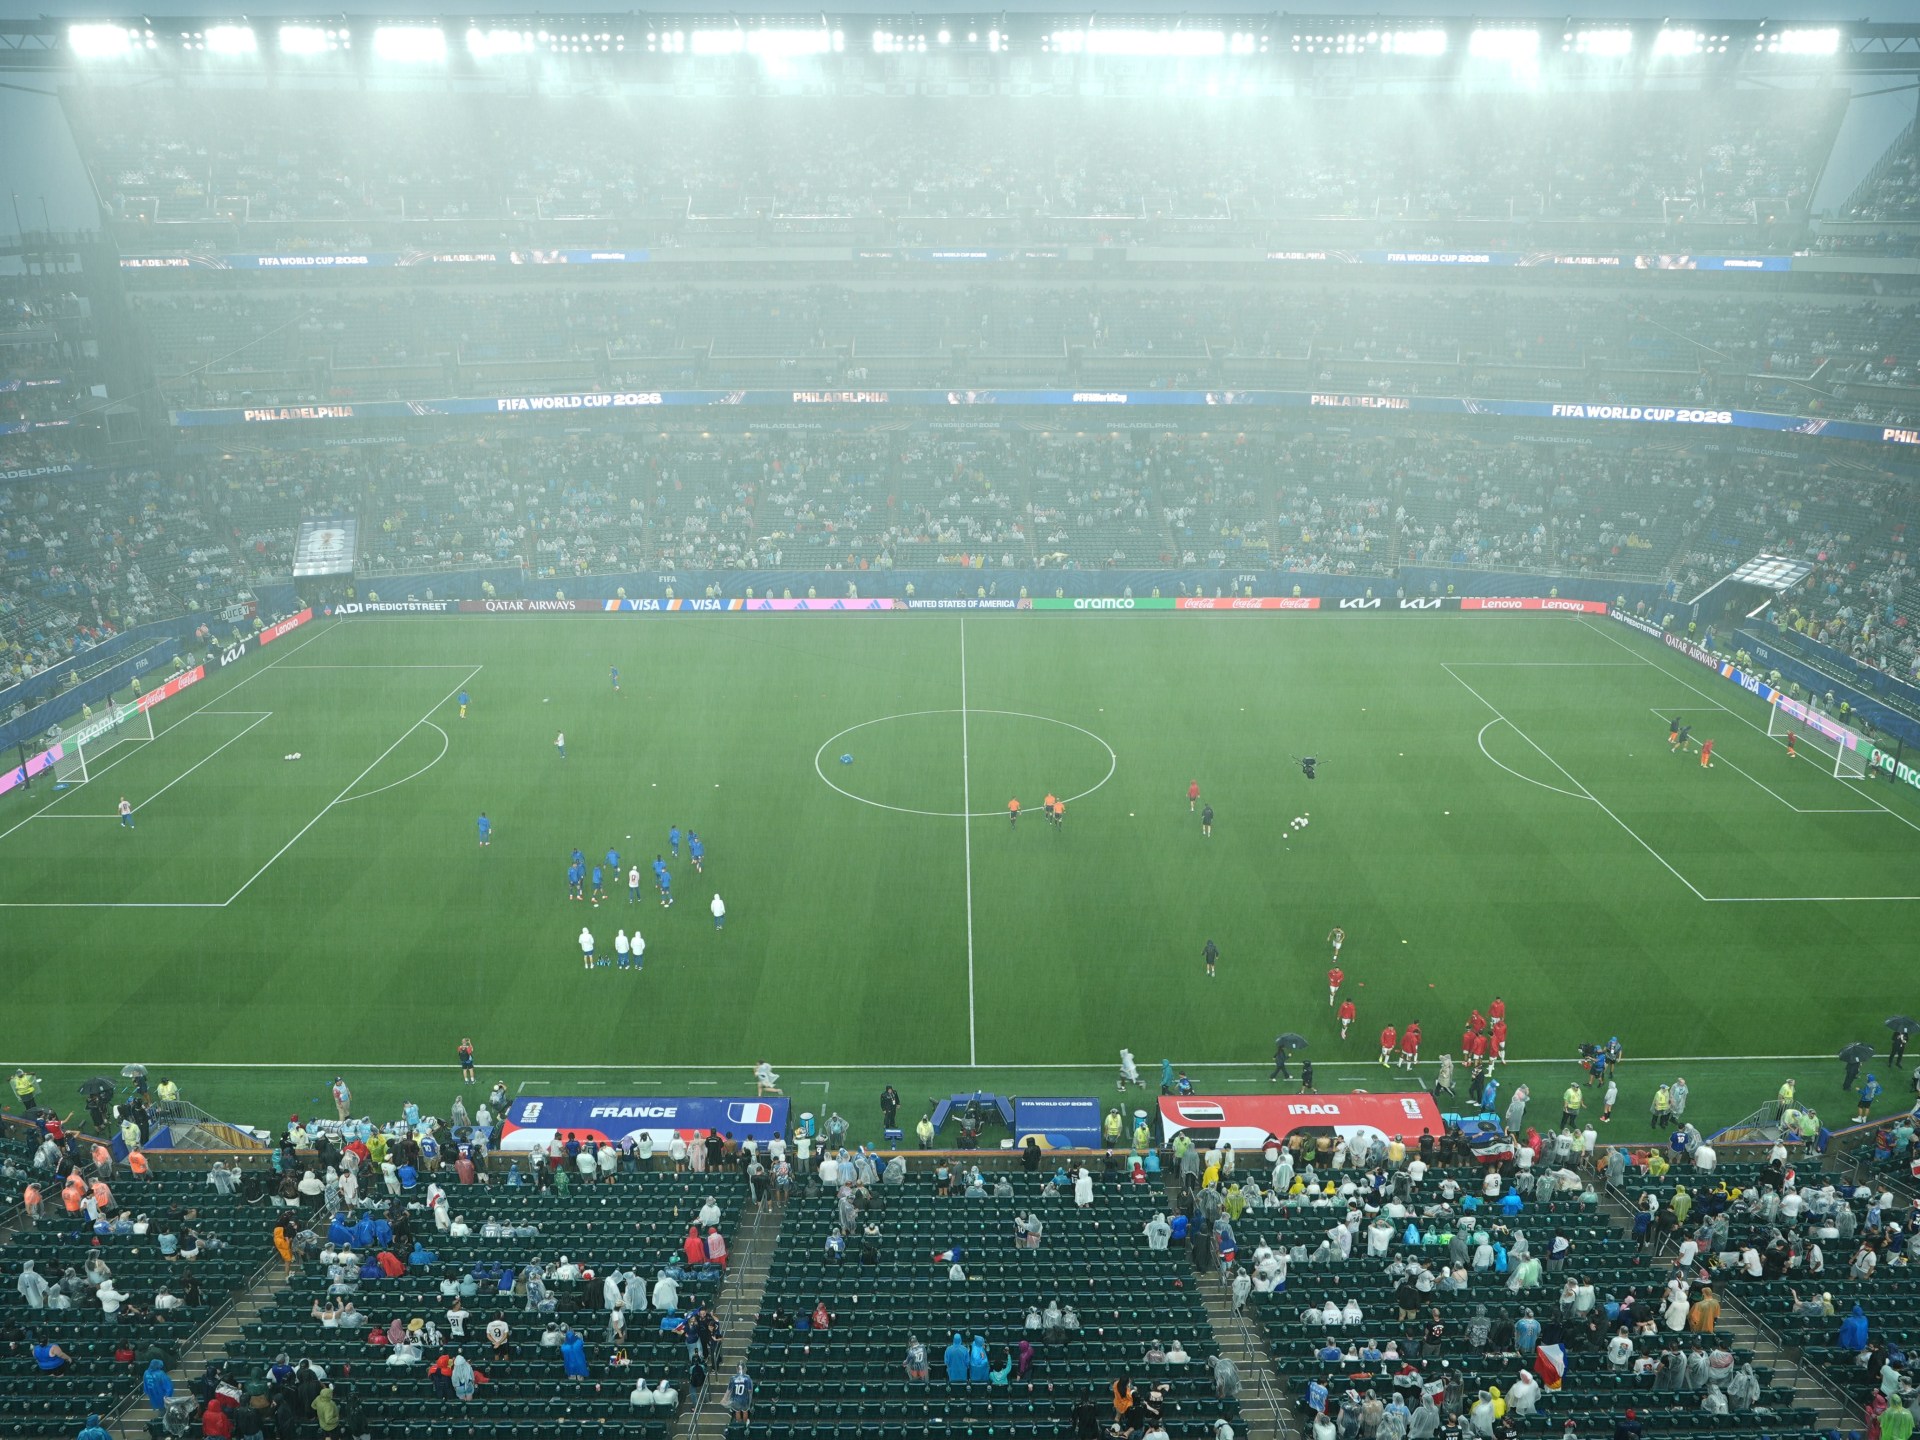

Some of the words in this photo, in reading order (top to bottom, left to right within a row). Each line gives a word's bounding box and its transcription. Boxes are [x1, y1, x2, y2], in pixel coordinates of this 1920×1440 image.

[259, 257, 280, 266] FIFA
[281, 257, 314, 265] WORLD
[315, 256, 333, 265] CUP
[1267, 252, 1325, 260] PHILADELPHIA
[1408, 254, 1438, 262] WORLD
[1440, 254, 1457, 262] CUP
[1458, 255, 1490, 263] 2026
[1554, 256, 1619, 265] PHILADELPHIA
[497, 398, 528, 411] FIFA
[529, 396, 581, 410] WORLD
[583, 395, 611, 408] CUP
[613, 393, 662, 406] 2026
[793, 391, 889, 403] PHILADELPHIA
[1311, 395, 1410, 409] PHILADELPHIA
[244, 406, 354, 421] PHILADELPHIA
[1552, 405, 1584, 418] FIFA
[1586, 405, 1642, 420] WORLD
[1643, 408, 1675, 421] CUP
[1676, 410, 1732, 424] 2026
[324, 436, 406, 446] PHILADELPHIA
[1513, 434, 1593, 444] PHILADELPHIA
[1736, 446, 1759, 454] WORLD
[1760, 448, 1774, 456] CUP
[1774, 451, 1799, 459] 2026
[335, 603, 363, 615] ADI
[365, 602, 447, 611] PREDICTSTREET
[486, 601, 524, 611] QATAR
[528, 600, 576, 610] AIRWAYS
[631, 600, 659, 610] VISA
[691, 600, 721, 610] VISA
[909, 600, 937, 608] UNITED
[938, 600, 966, 608] STATES
[967, 600, 978, 608] OF
[979, 600, 1015, 608] AMERICA
[1074, 598, 1134, 609] aramco
[1184, 598, 1215, 609] Coca-Cola
[1232, 598, 1262, 609] Coca-Cola
[1280, 598, 1309, 609] Coca-Cola
[1481, 599, 1522, 609] Lenovo
[1541, 599, 1584, 611] Lenovo
[275, 617, 299, 636] Lenovo
[1611, 609, 1623, 622] ADI
[1624, 616, 1662, 638] PREDICTSTREET
[1665, 634, 1687, 654] QATAR
[1688, 646, 1718, 670] AIRWAYS
[1756, 647, 1768, 659] FIFA
[136, 658, 149, 670] FIFA
[1741, 672, 1759, 694] VISA
[590, 1107, 677, 1118] FRANCE
[1287, 1104, 1340, 1115] IRAQ
[451, 1319, 459, 1328] 21
[494, 1328, 501, 1338] 9
[915, 1352, 923, 1362] 10
[735, 1385, 745, 1396] 10
